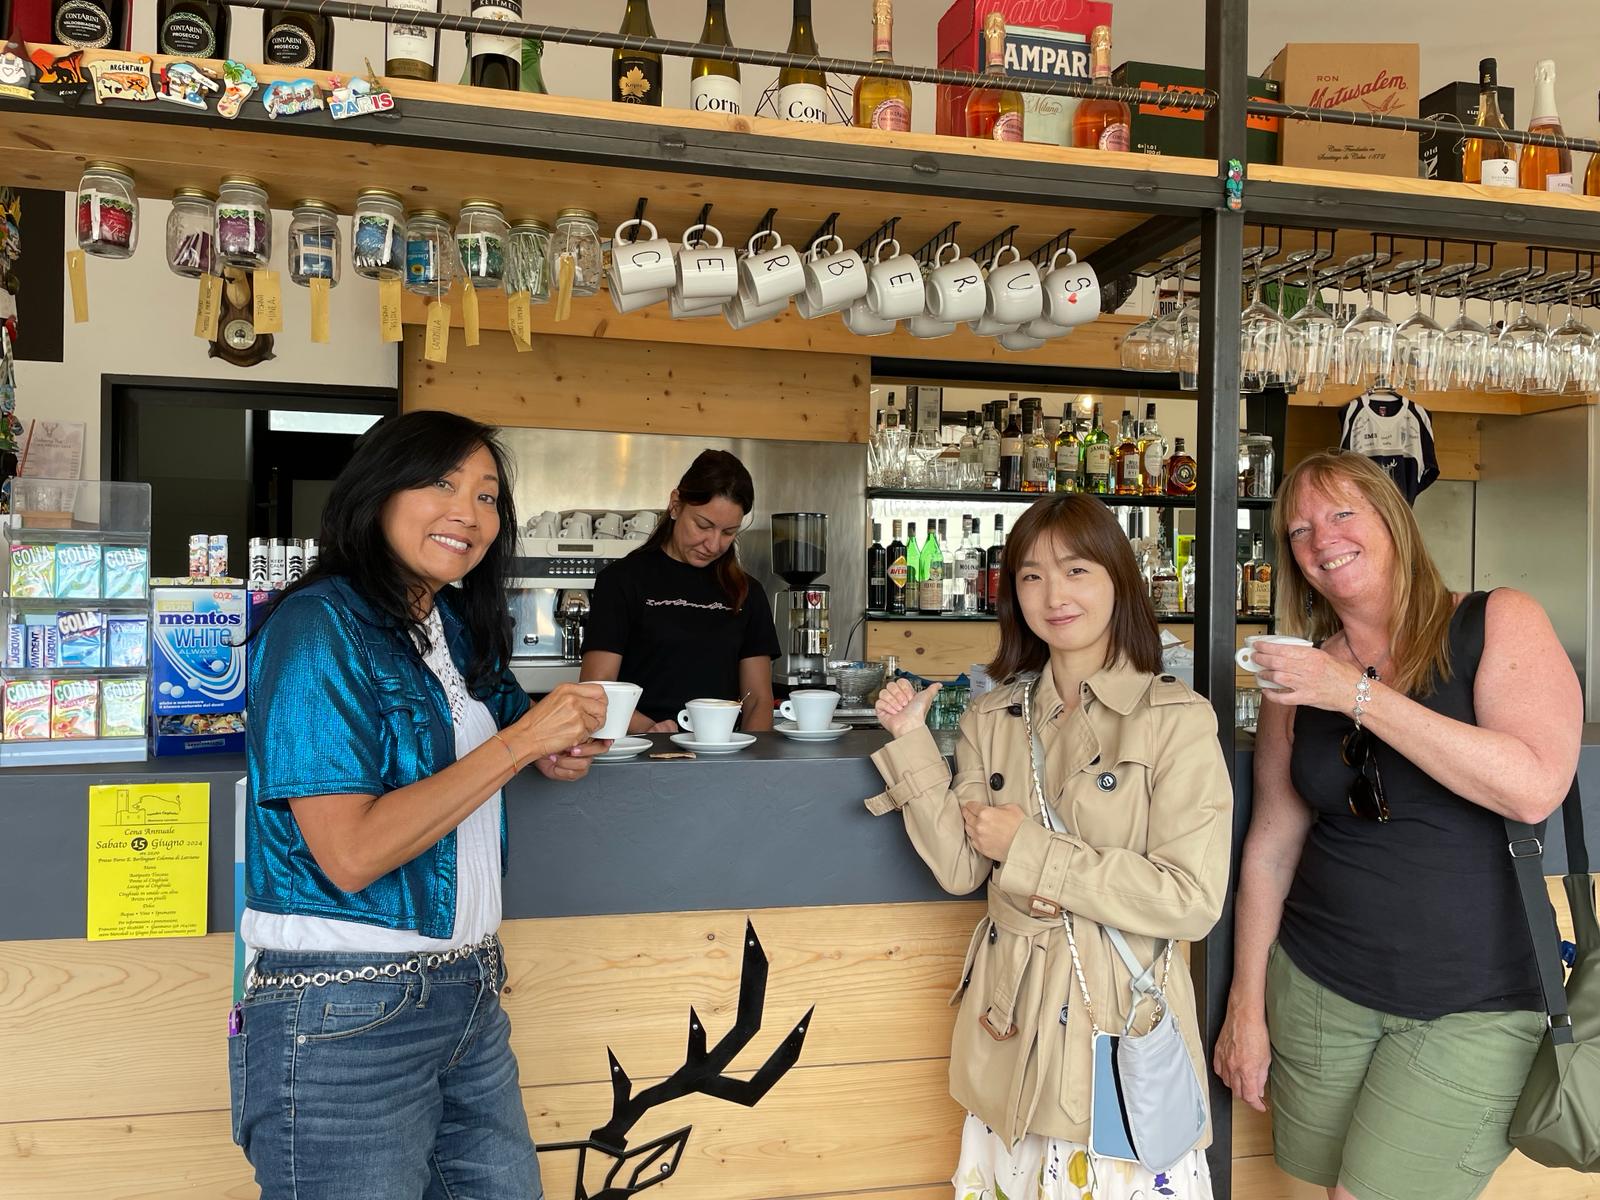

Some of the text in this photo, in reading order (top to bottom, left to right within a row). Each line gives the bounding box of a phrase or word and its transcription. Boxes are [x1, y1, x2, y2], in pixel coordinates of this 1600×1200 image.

[65, 12, 99, 23] CONTARINI
[170, 24, 203, 34] CONTARINI
[172, 32, 200, 40] PROSECCO
[271, 36, 302, 44] CONTARINI
[1005, 42, 1092, 78] AMPAR
[110, 64, 144, 72] ARGENTINA
[1308, 69, 1409, 109] Matusalem
[331, 92, 394, 116] PARIS
[1030, 102, 1060, 114] Milano
[59, 611, 101, 635] GOLIA
[159, 612, 241, 625] mentos
[10, 626, 20, 663] VIVIDENT
[124, 826, 175, 836] Cena Annuale
[96, 838, 128, 850] Sabato
[132, 840, 147, 850] 15
[151, 838, 184, 851] Giugno
